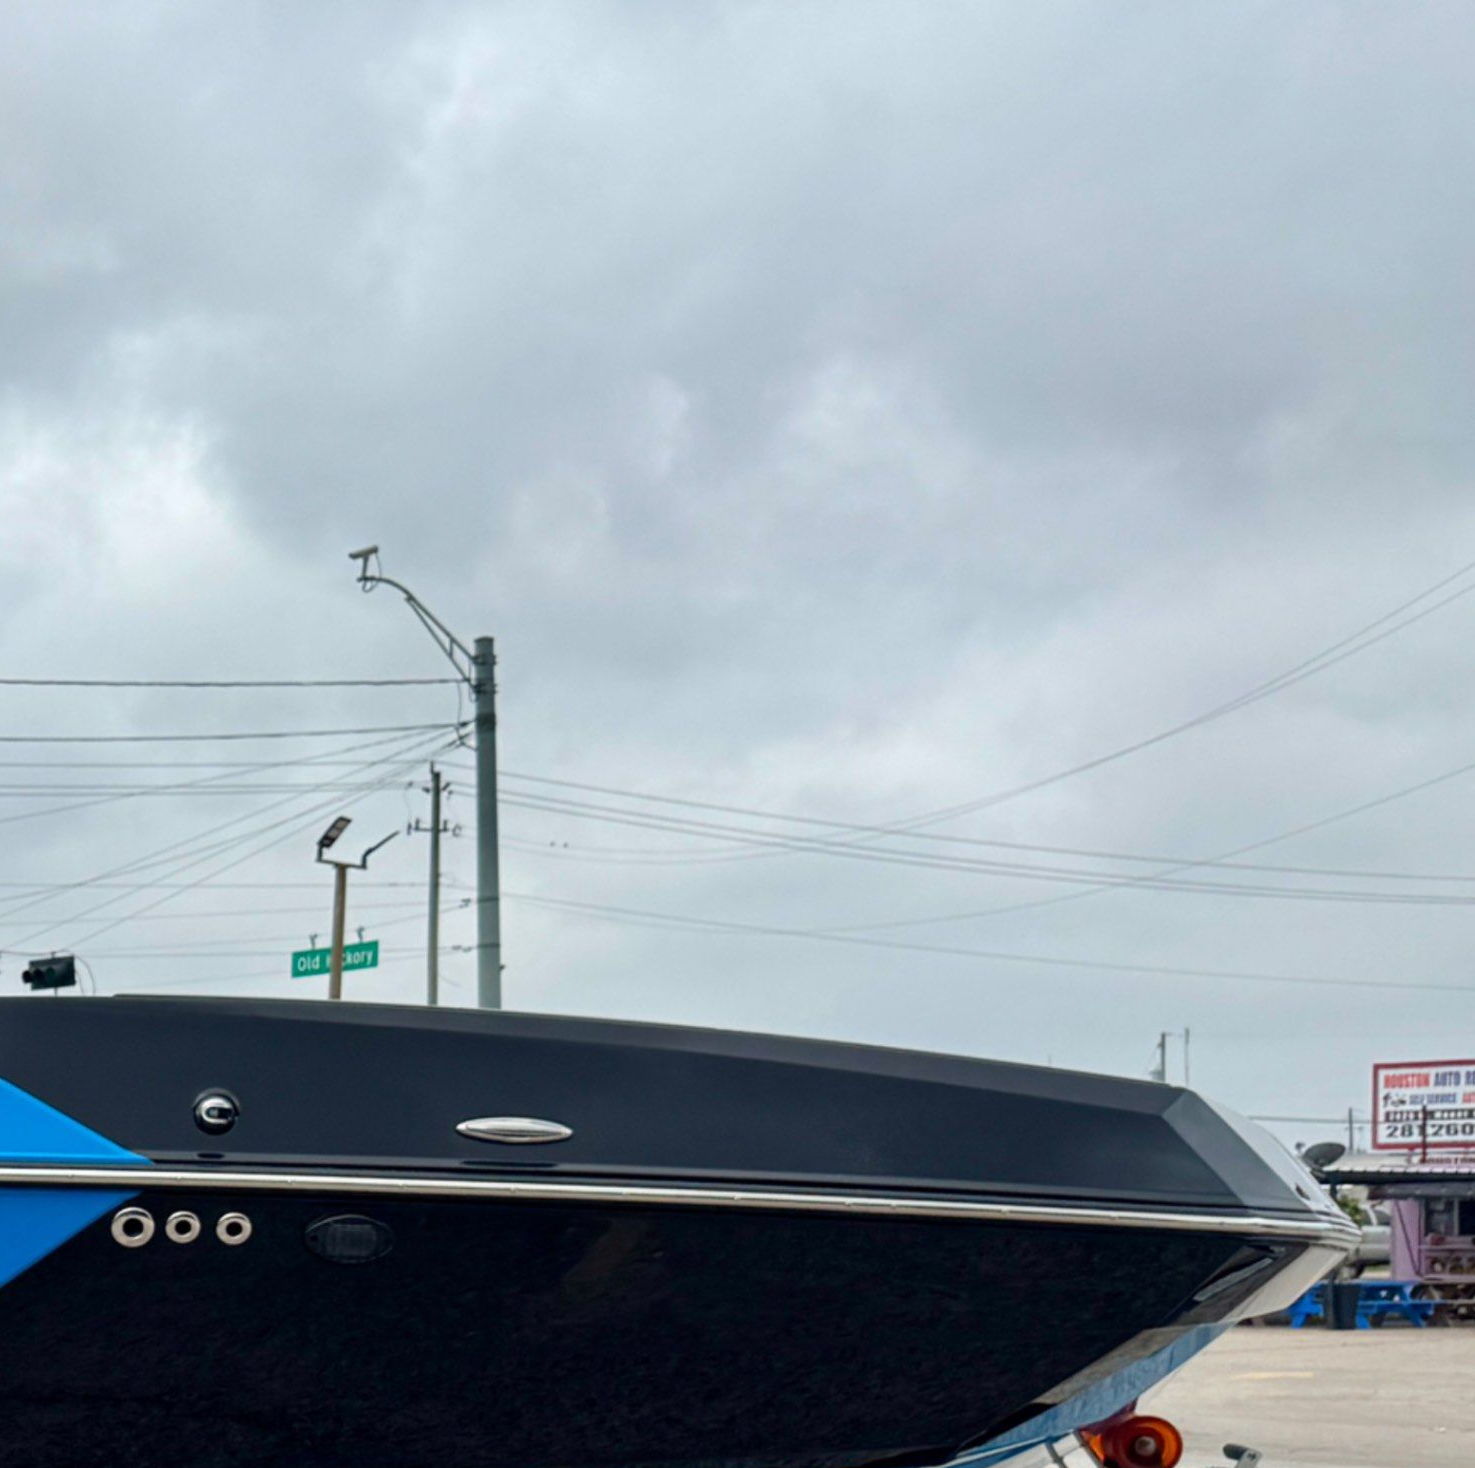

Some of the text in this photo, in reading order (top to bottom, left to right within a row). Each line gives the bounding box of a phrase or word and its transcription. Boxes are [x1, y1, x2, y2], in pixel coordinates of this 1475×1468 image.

[297, 950, 373, 971] Old kory
[1384, 1072, 1431, 1088] HOUSTON
[1434, 1071, 1461, 1087] AUTO
